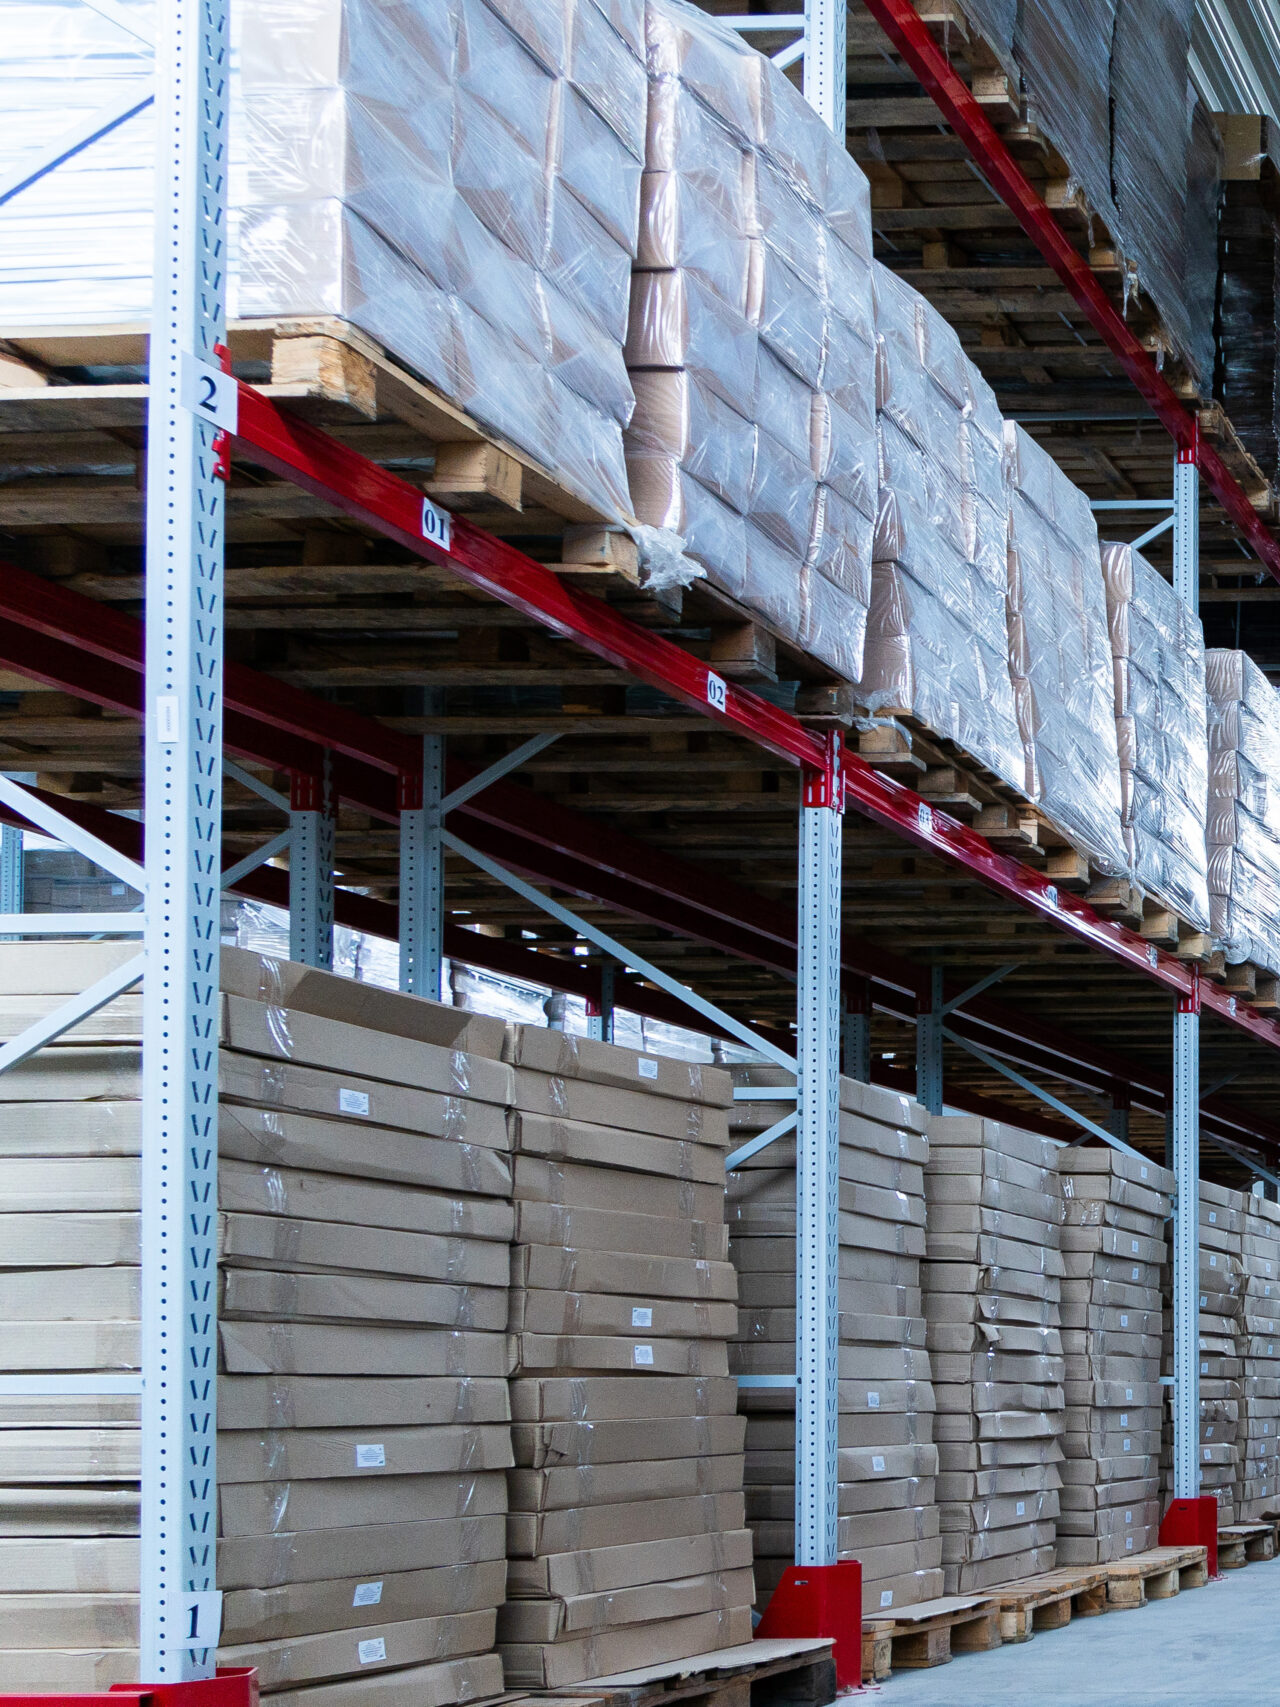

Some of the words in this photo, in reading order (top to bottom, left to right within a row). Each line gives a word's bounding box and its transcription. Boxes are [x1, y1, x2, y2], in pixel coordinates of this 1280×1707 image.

[199, 375, 218, 413] 2
[424, 509, 445, 542] 01
[709, 680, 724, 706] 02
[186, 1603, 200, 1639] 1
